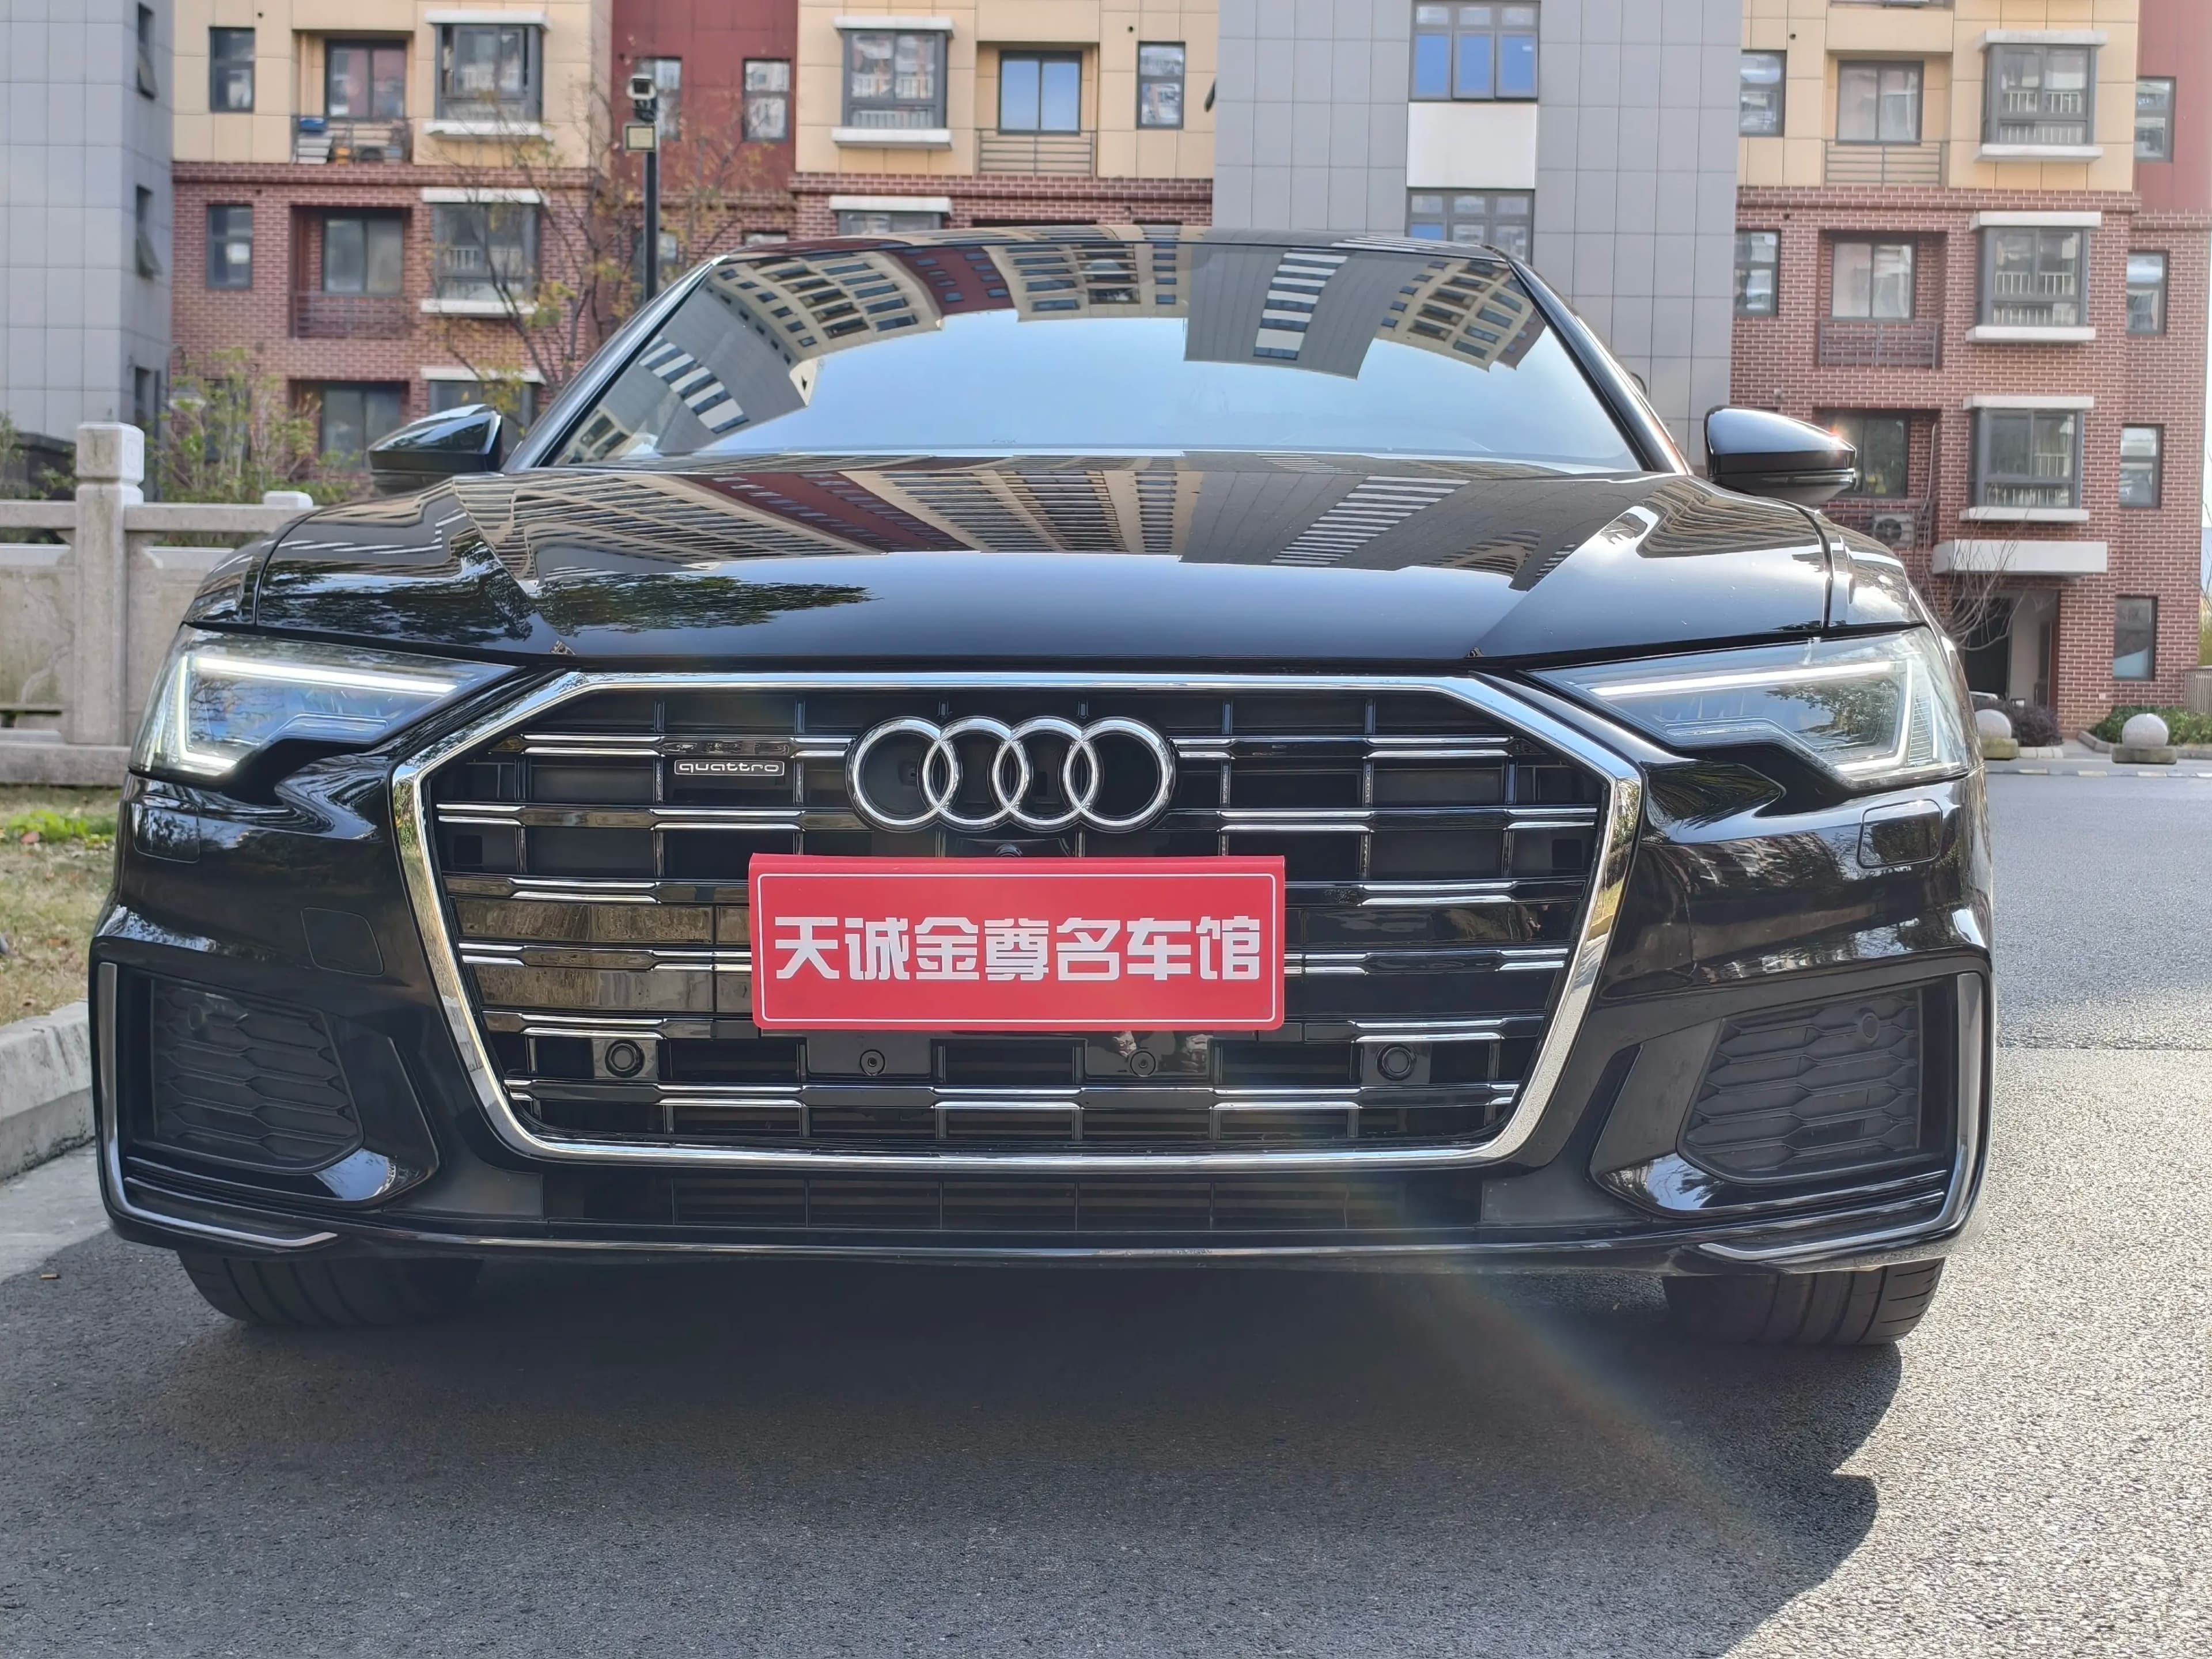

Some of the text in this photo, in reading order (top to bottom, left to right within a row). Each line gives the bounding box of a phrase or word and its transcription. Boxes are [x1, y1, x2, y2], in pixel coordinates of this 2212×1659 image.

[679, 762, 779, 773] quattro
[774, 915, 1260, 982] 天诚金尊名车馆
